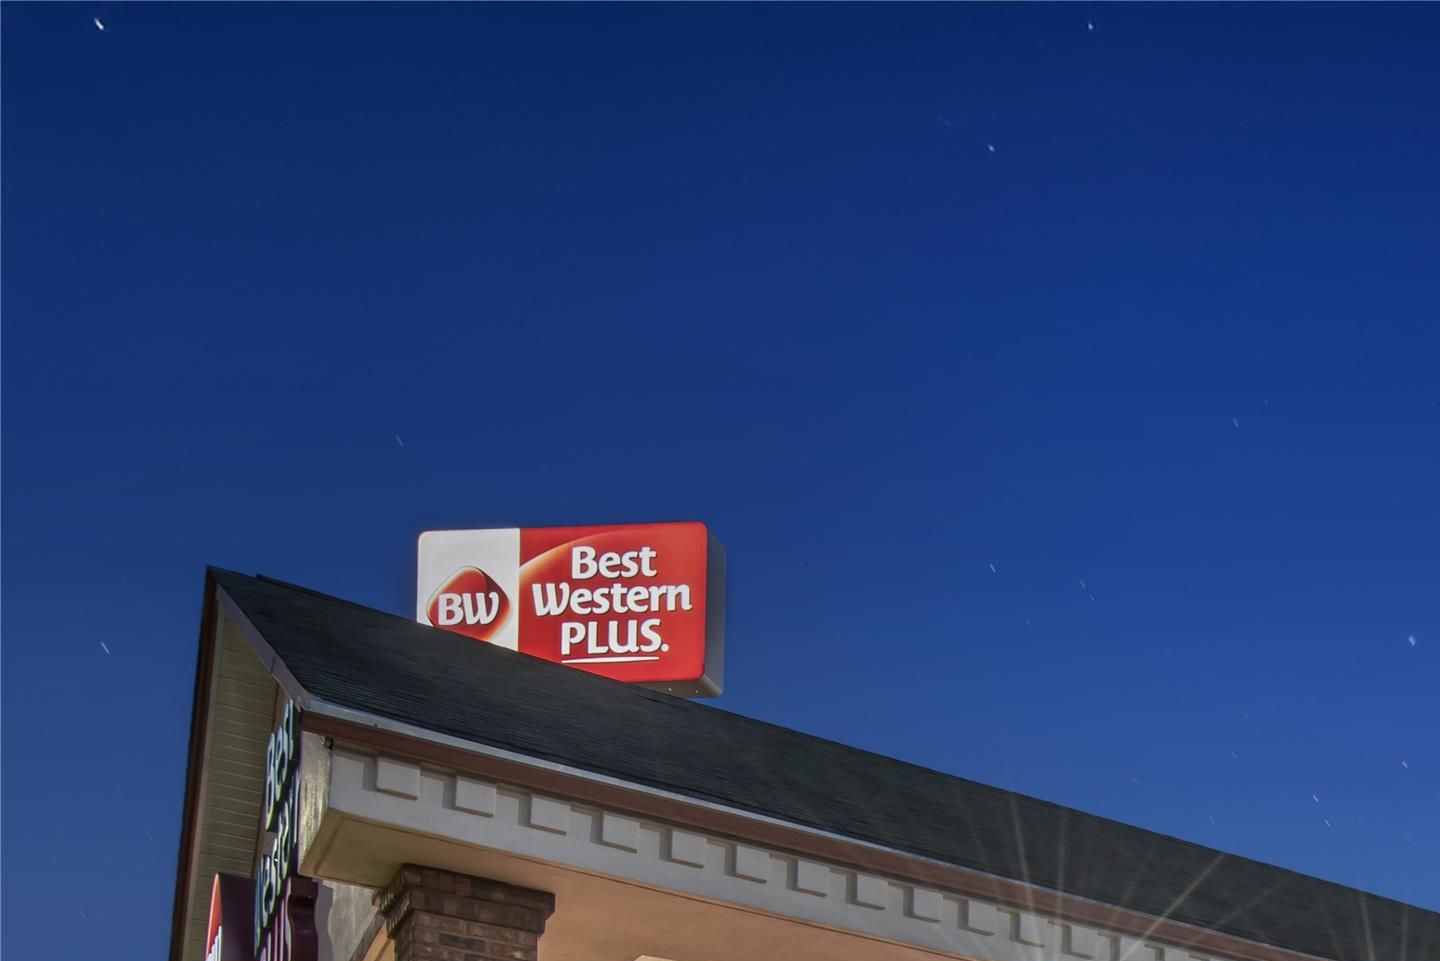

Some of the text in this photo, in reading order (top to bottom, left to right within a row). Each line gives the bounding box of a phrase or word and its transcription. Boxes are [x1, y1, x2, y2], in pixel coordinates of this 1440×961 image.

[571, 545, 658, 580] Best
[437, 591, 500, 626] BW
[531, 582, 693, 617] Western
